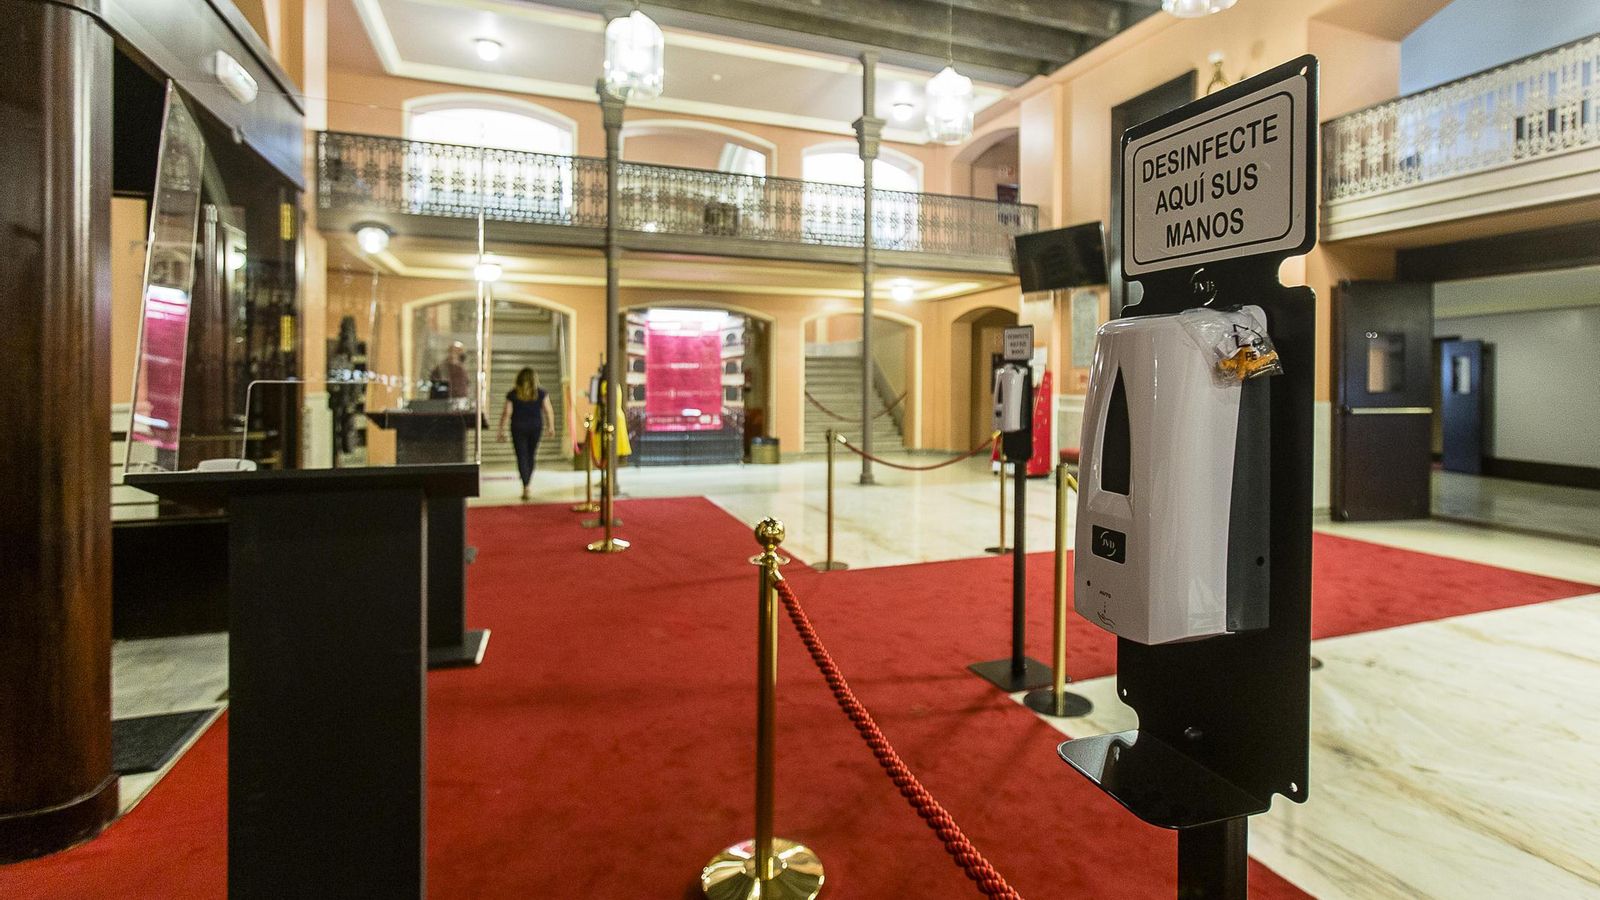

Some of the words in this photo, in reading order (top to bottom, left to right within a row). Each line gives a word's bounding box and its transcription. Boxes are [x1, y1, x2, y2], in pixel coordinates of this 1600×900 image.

[1142, 113, 1278, 184] DESINFECTE
[1155, 172, 1205, 215] AQUÍ
[1211, 163, 1259, 200] SUS
[1166, 207, 1244, 248] MANOS
